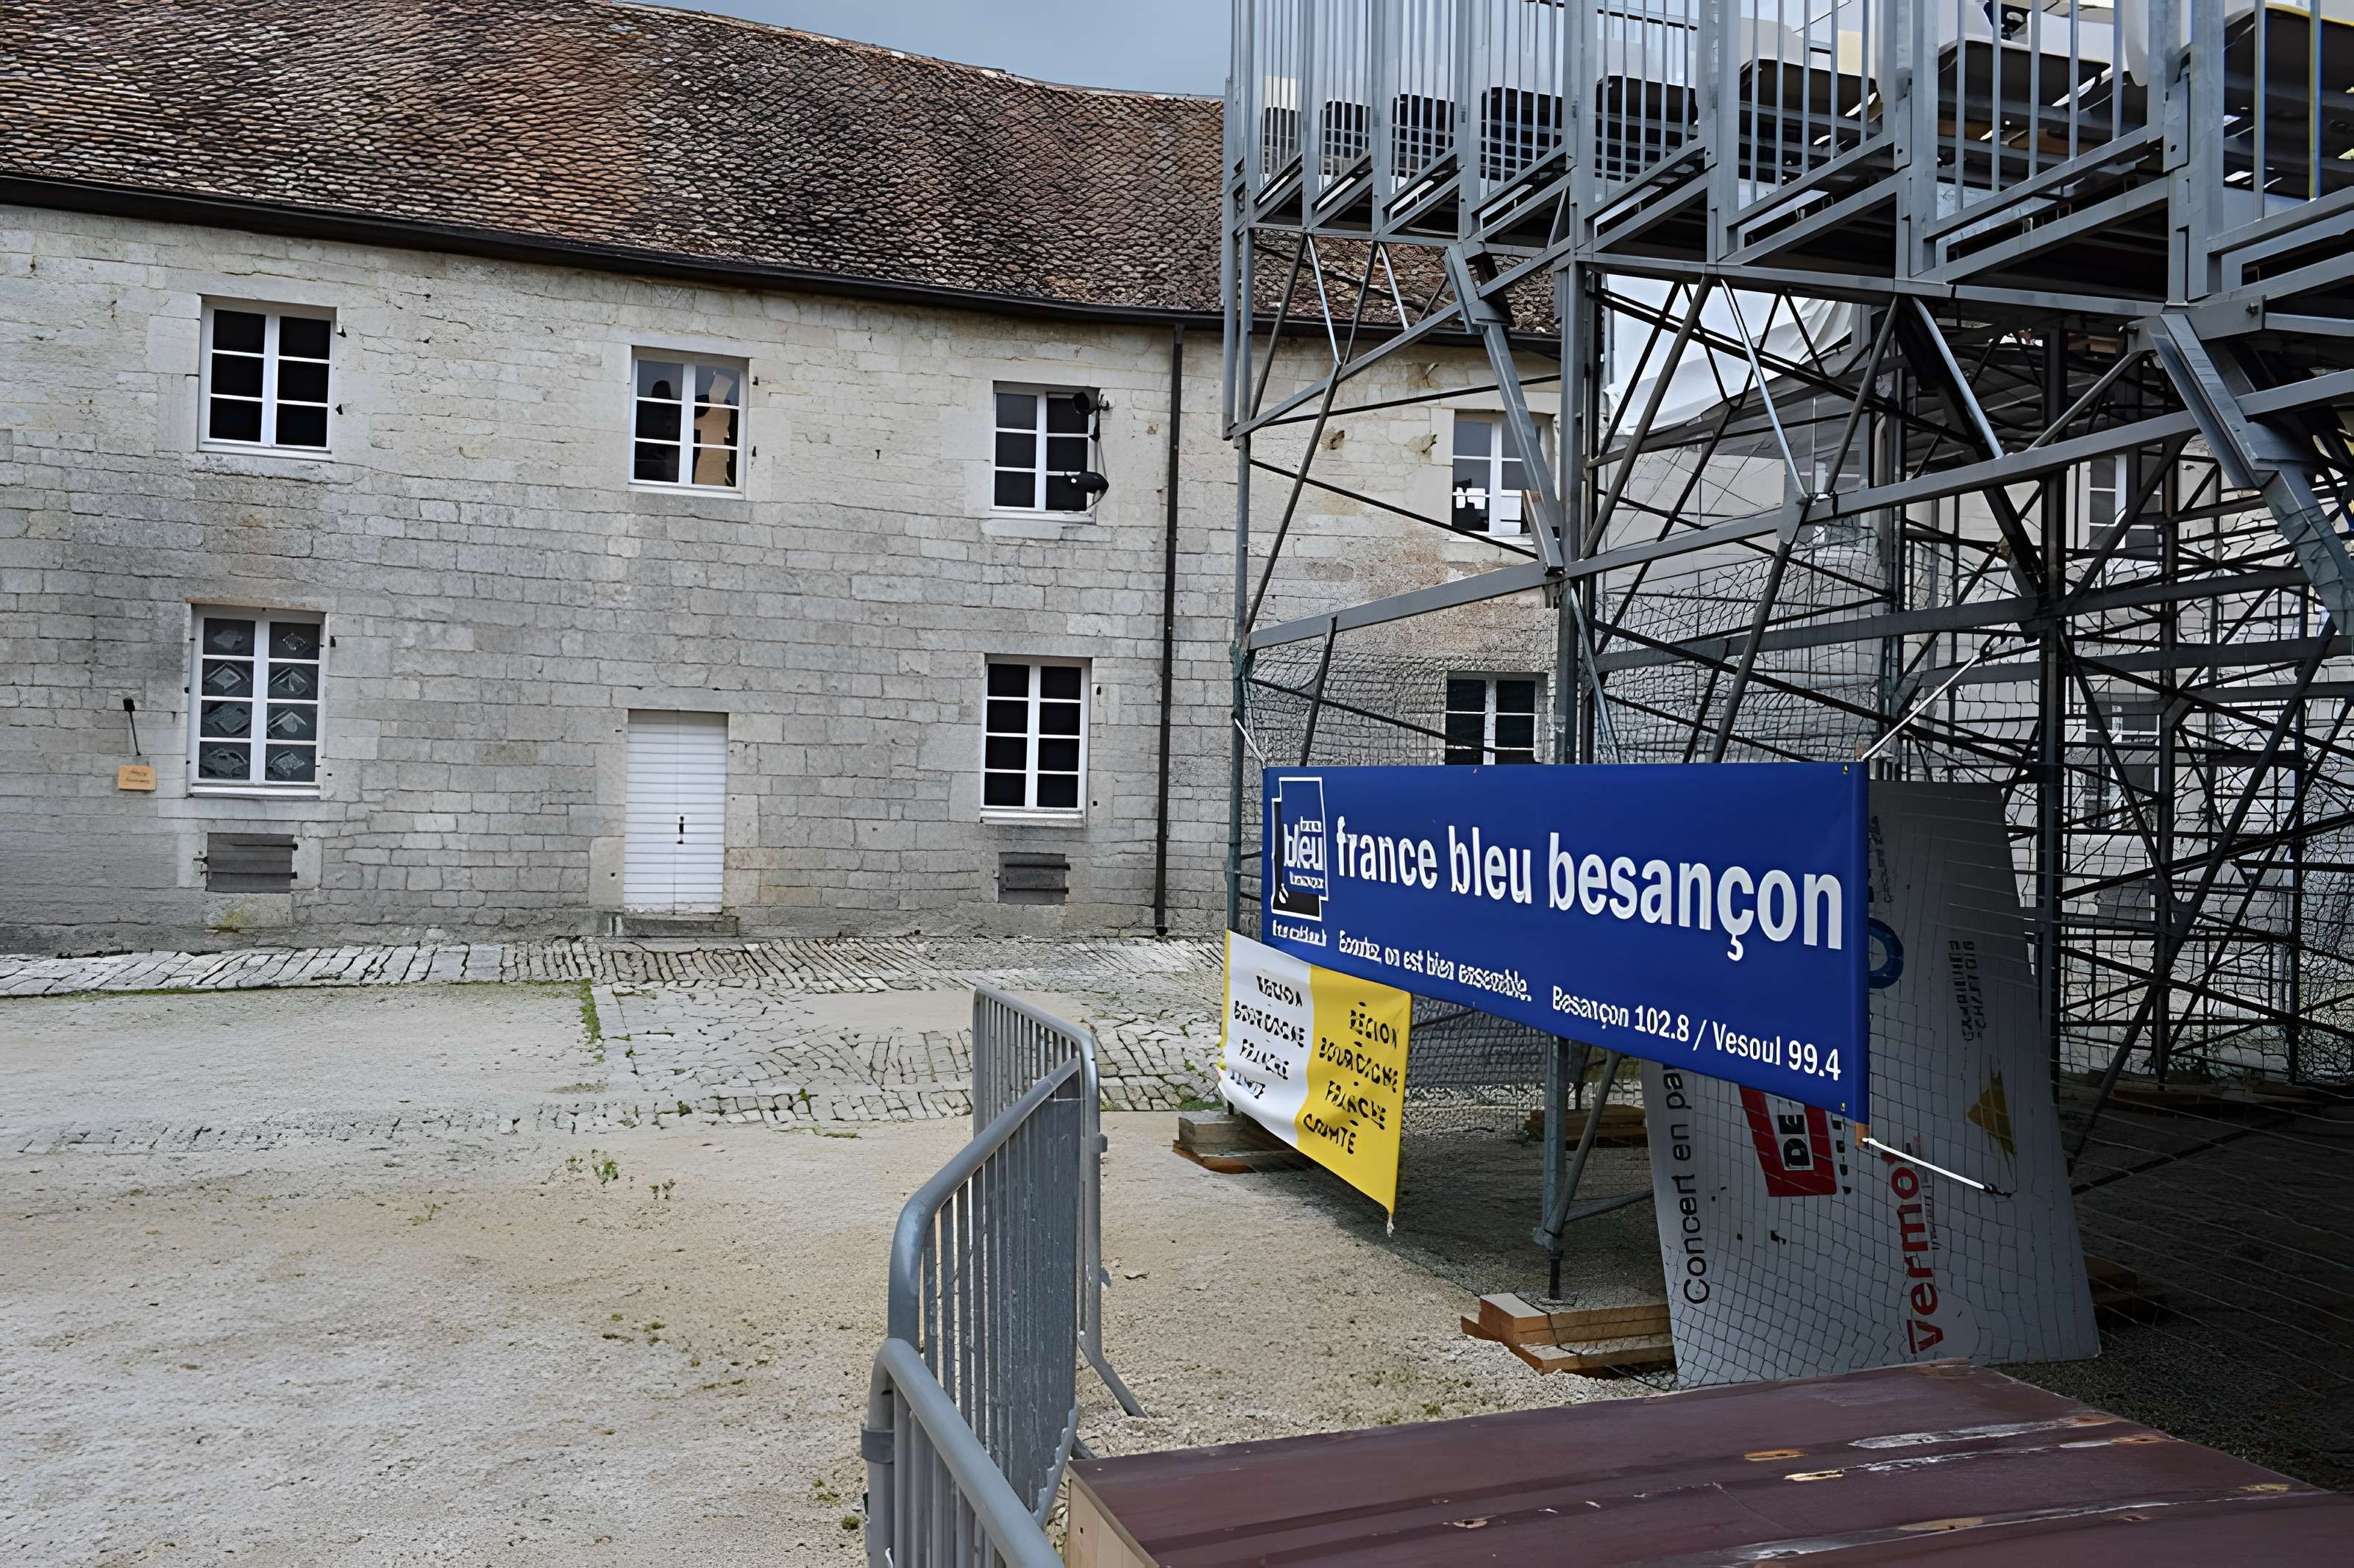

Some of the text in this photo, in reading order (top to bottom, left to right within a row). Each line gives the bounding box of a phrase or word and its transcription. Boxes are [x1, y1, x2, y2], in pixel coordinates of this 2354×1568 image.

[1336, 815, 1438, 890] france
[1448, 824, 1532, 905] bleu
[1548, 831, 1843, 962] besançon
[1552, 985, 1841, 1082] Besançon 102.8 / Vesoul 99.4
[1670, 1123, 1692, 1162] en
[1671, 1173, 1711, 1305] Concert
